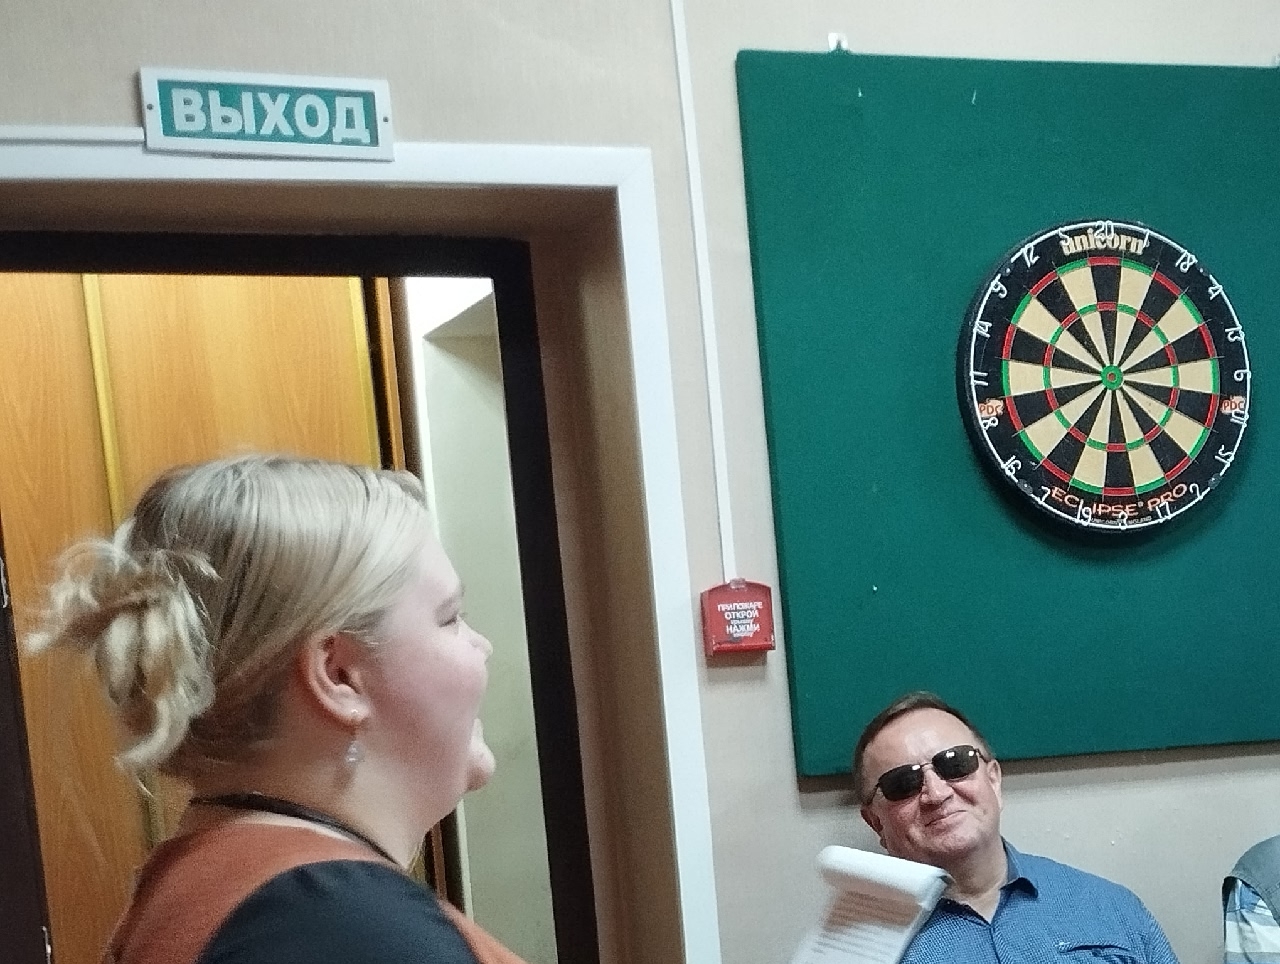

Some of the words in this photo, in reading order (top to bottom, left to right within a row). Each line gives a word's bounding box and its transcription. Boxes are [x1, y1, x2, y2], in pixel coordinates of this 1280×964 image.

[171, 88, 371, 144] ВЫХОД
[1094, 220, 1115, 240] 20
[1175, 250, 1198, 273] 18
[1225, 325, 1245, 342] 13
[1214, 444, 1234, 467] 15
[1051, 486, 1139, 517] ECIPSE
[1147, 483, 1187, 511] PRO
